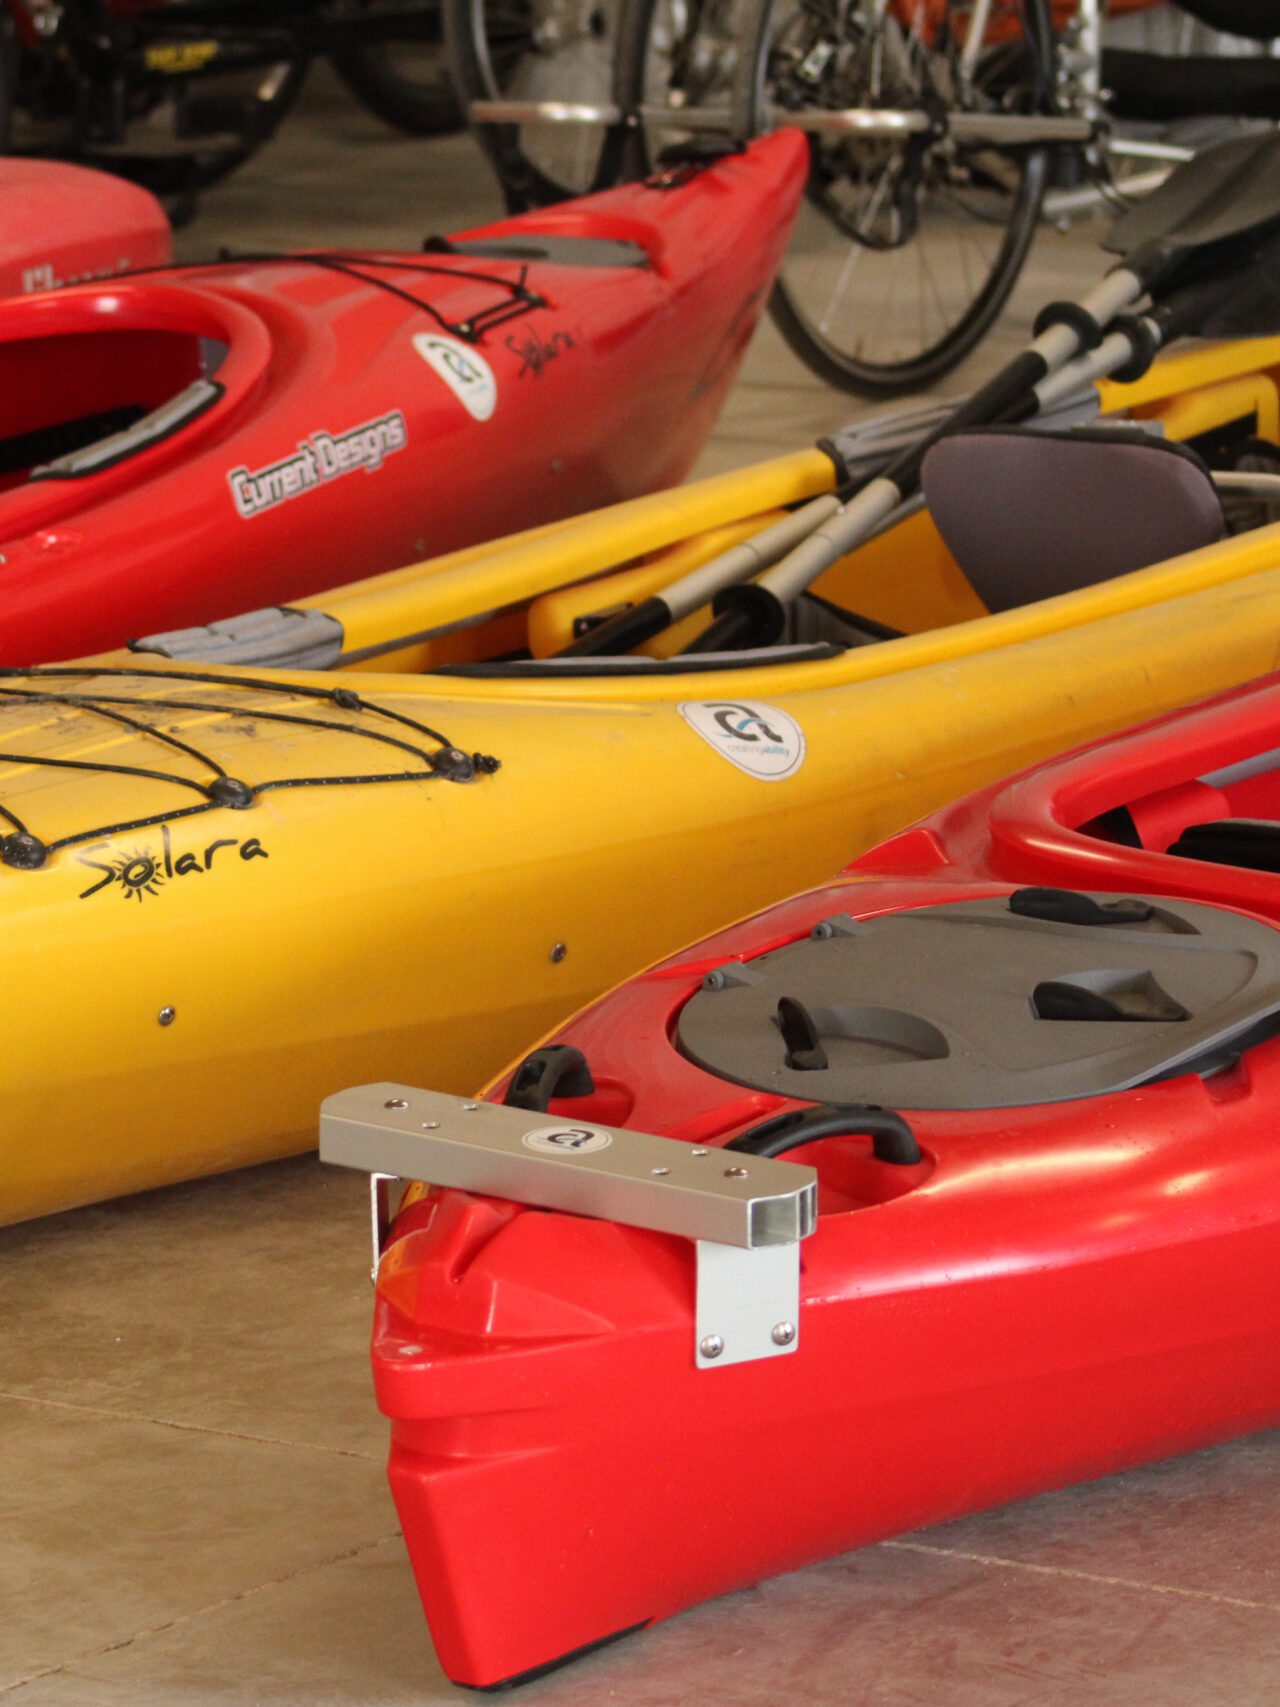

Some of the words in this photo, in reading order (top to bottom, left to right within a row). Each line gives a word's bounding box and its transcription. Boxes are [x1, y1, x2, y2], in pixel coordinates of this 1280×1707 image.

[227, 440, 322, 519] Current
[311, 408, 408, 483] Designs
[74, 825, 269, 903] Solara
